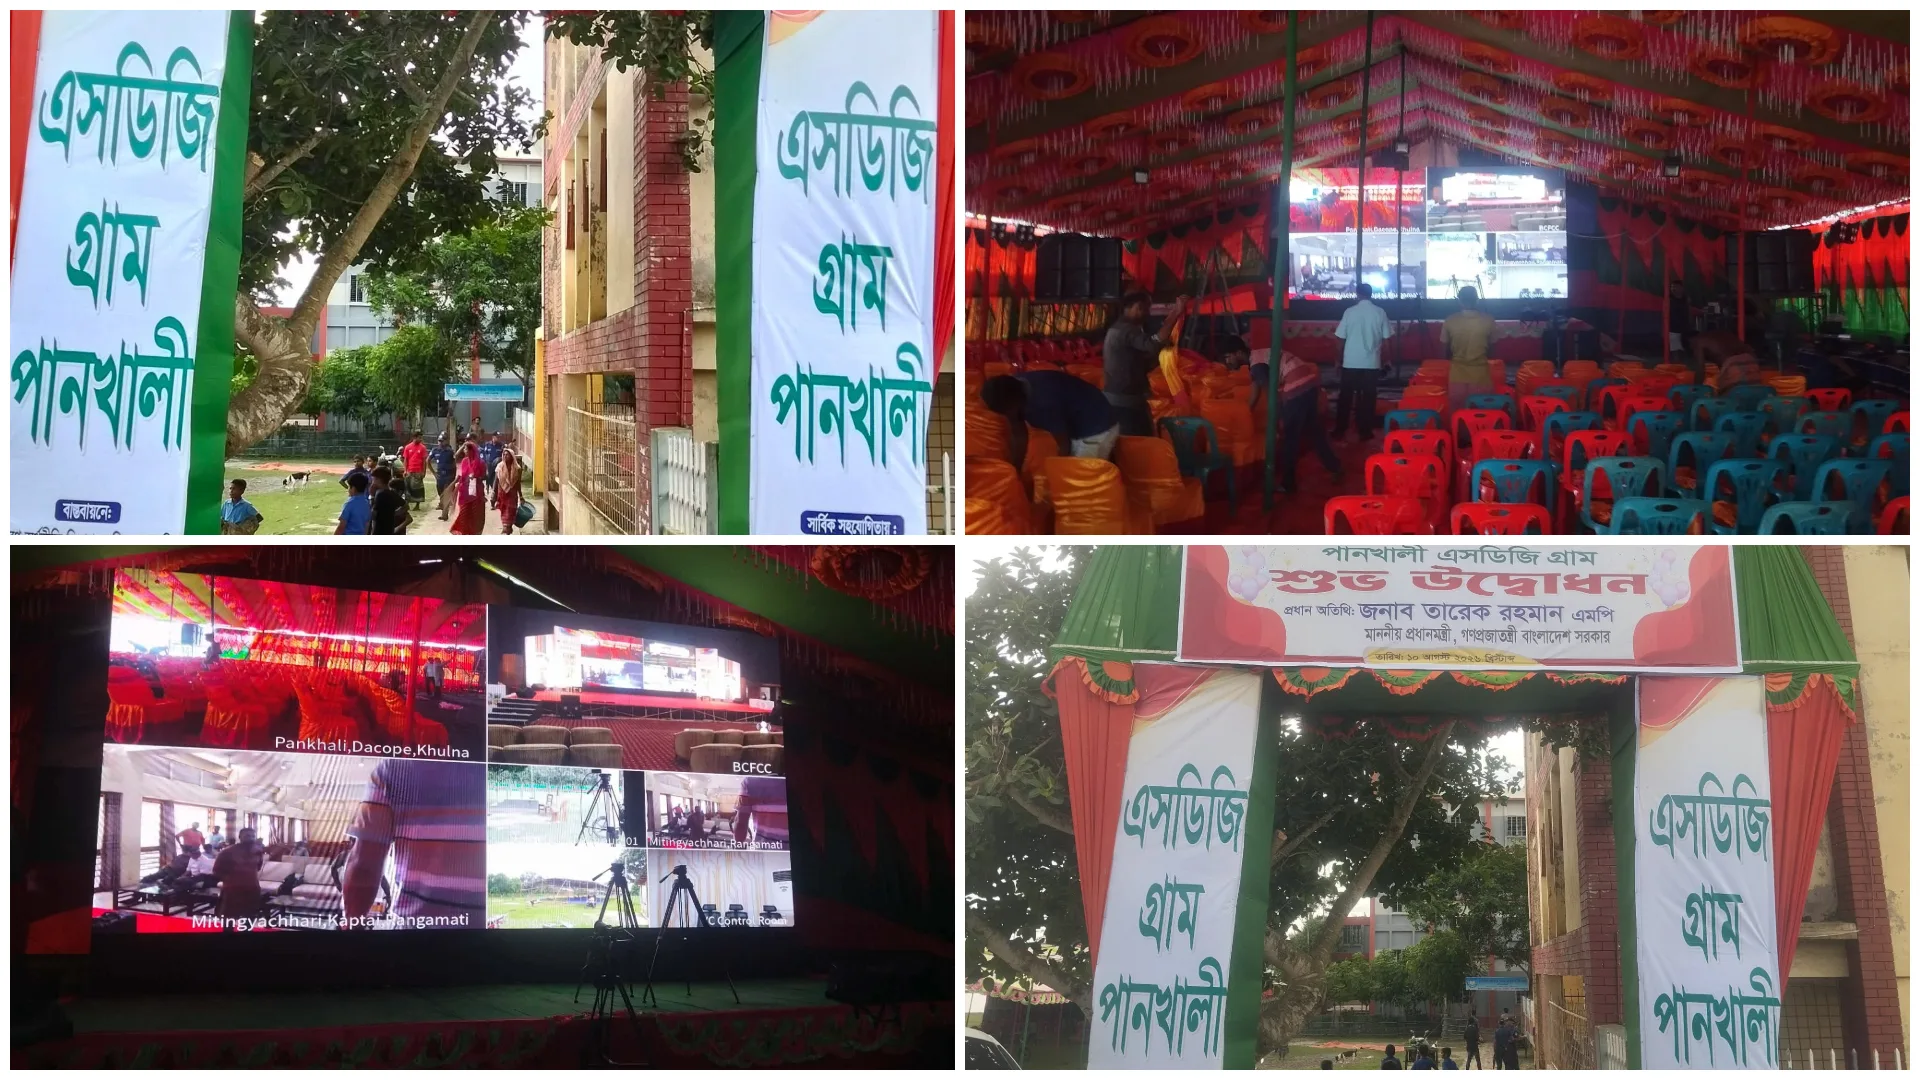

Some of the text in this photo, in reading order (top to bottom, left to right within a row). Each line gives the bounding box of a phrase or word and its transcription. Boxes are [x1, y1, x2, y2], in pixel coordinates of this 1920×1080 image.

[39, 41, 220, 173] এসডিজি
[777, 80, 937, 204] এসডিজি
[67, 198, 161, 309] গ্রাম
[812, 230, 894, 335] গ্রাম
[11, 316, 195, 453] পানখালী
[771, 341, 933, 467] পানখালী
[807, 513, 837, 533] সার্বিক
[1322, 545, 1598, 566] পানখালী এসডিজি গ্রাম
[1269, 565, 1649, 596] শুভ উদ্বোধন
[1283, 602, 1615, 623] প্রধান অতিথি: জনাব তারেক রহমান এমপি
[1364, 623, 1403, 642] মাননীয়
[1521, 630, 1572, 644] বাংলাদেশ
[1575, 630, 1611, 644] সরকার
[1407, 654, 1419, 662] ১০
[1422, 652, 1450, 661] আগস্ট
[274, 736, 470, 758] Pankhali,Dacope,Khulna
[732, 761, 772, 774] BCFCC
[1123, 763, 1248, 853] এসডিজি
[1650, 771, 1771, 862] এসডিজি
[191, 912, 470, 932] Mitingyachhari,Kaptai,Rangamati
[717, 916, 755, 926] Control
[758, 916, 787, 926] Room
[1139, 872, 1206, 953] গ্রাম
[1682, 883, 1743, 962] গ্রাম
[1100, 957, 1227, 1058] পানখালী
[1654, 966, 1780, 1066] পানখালী
